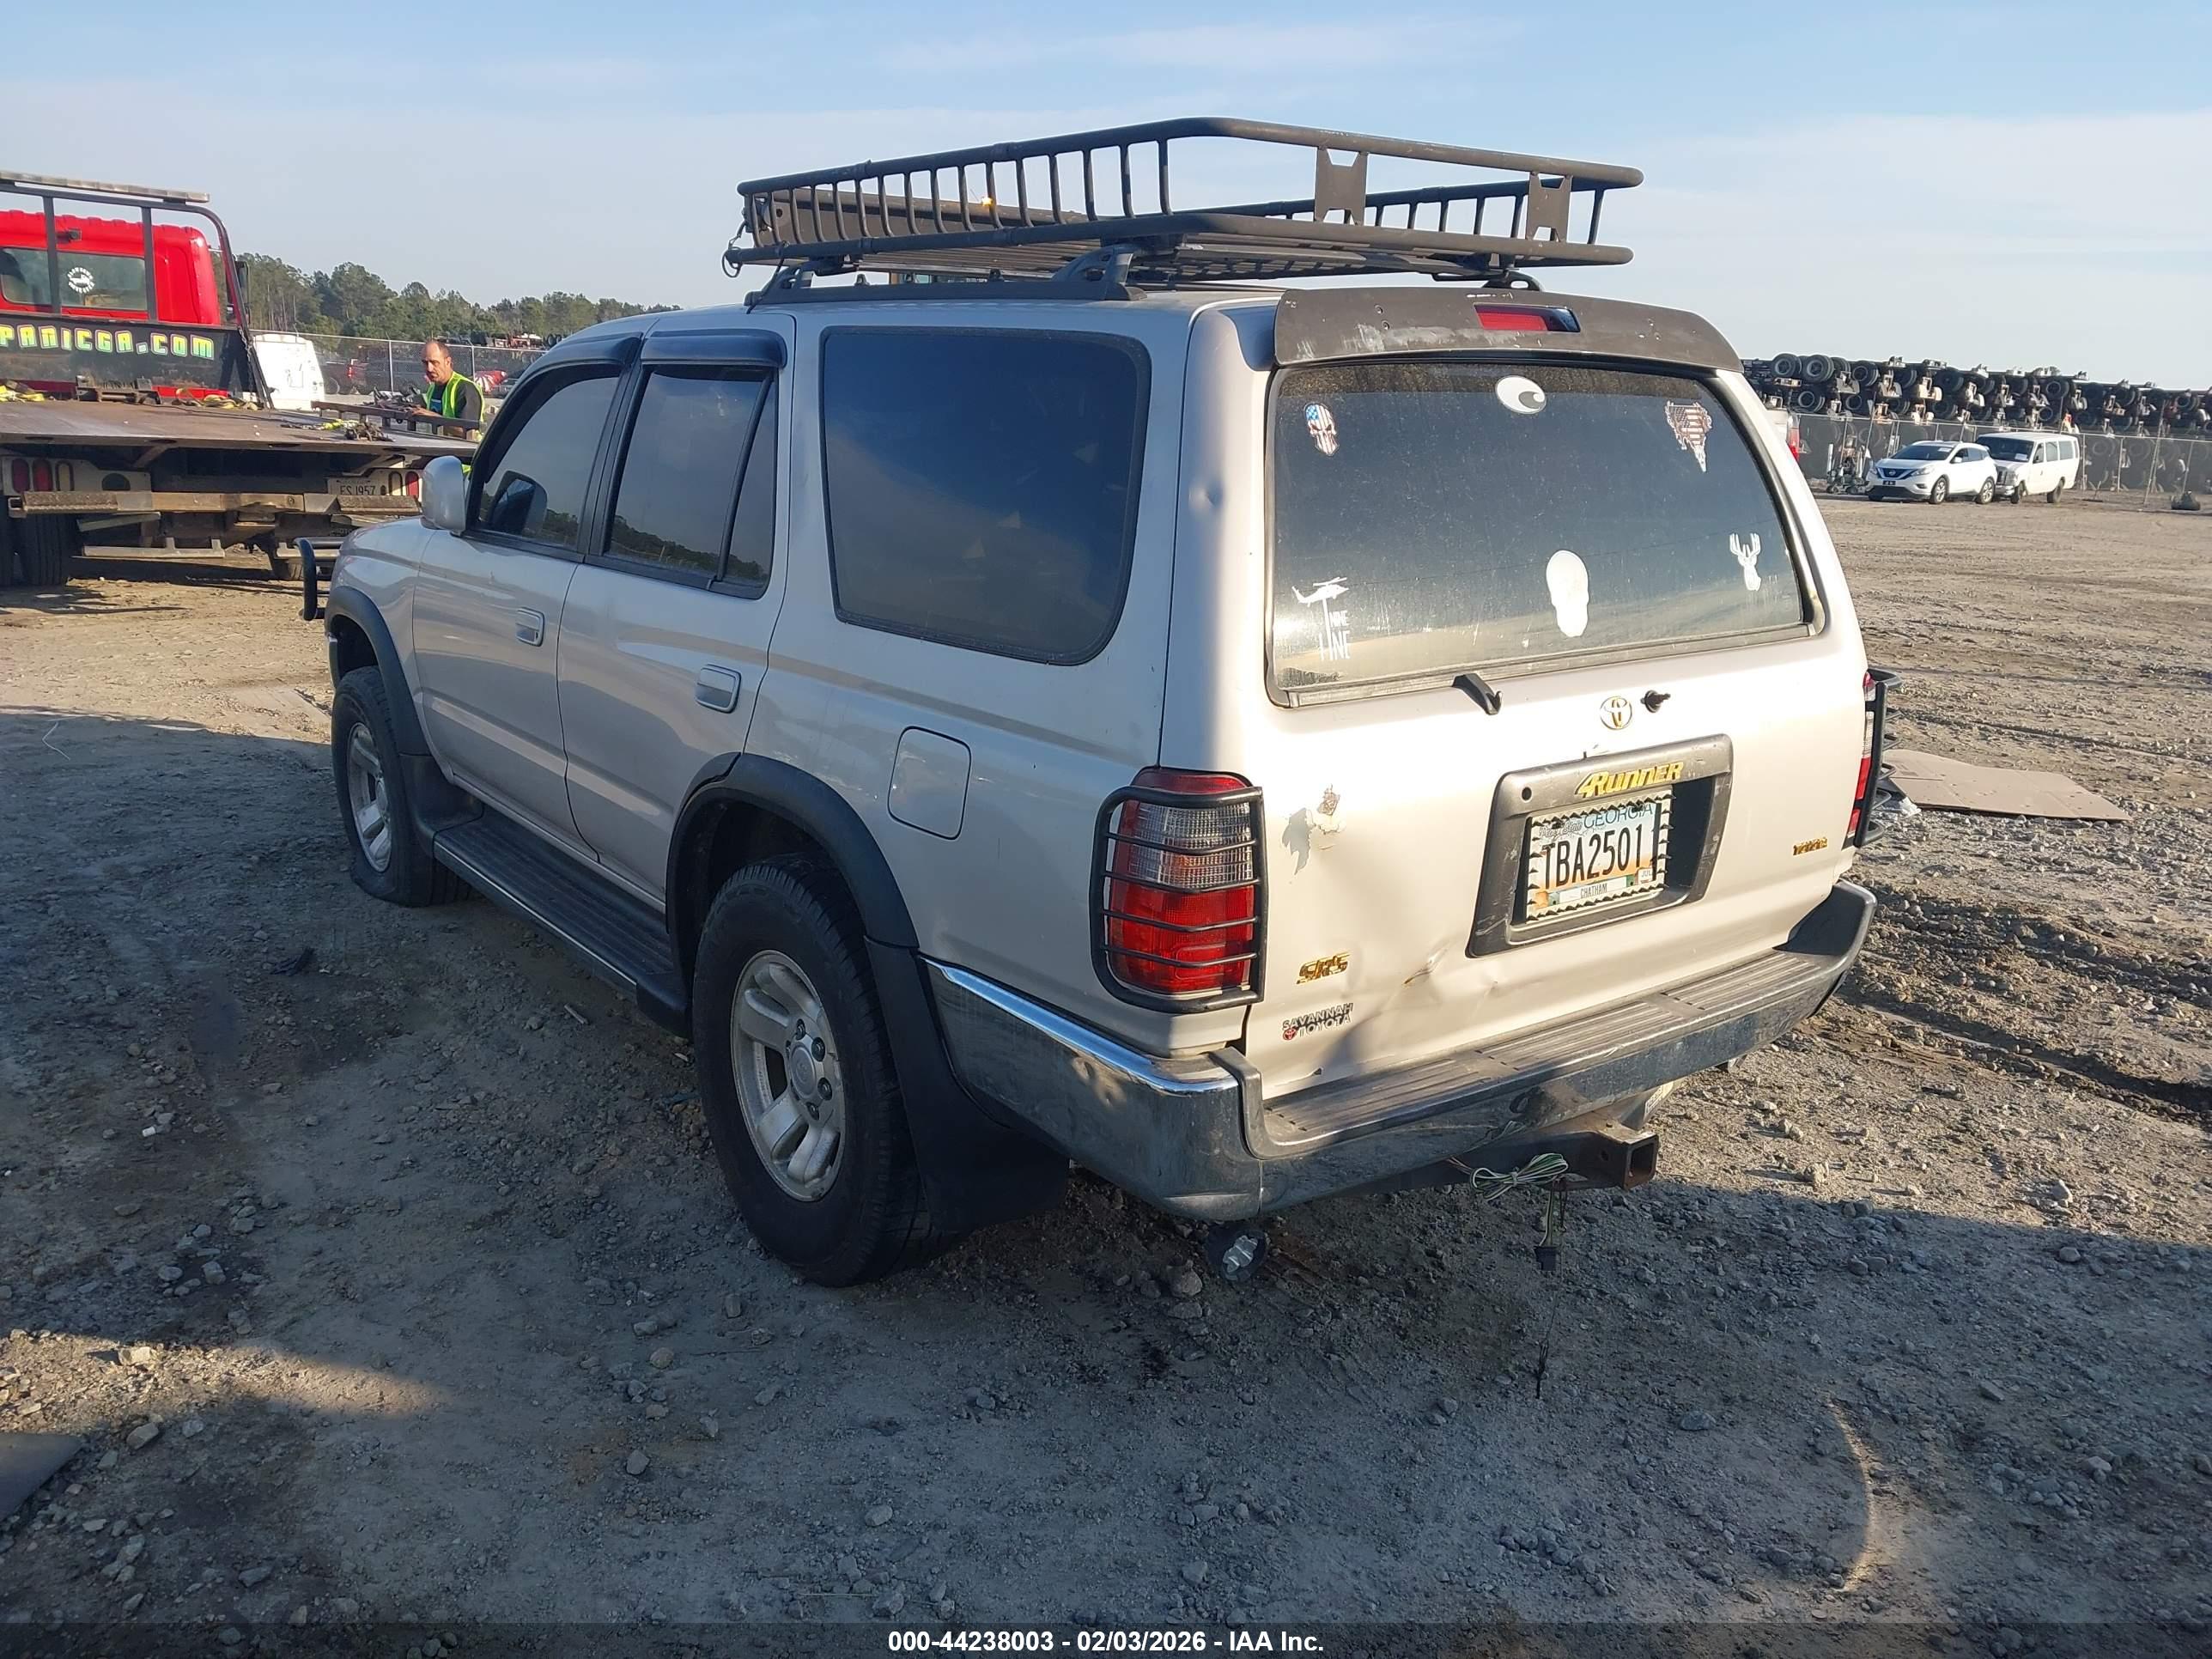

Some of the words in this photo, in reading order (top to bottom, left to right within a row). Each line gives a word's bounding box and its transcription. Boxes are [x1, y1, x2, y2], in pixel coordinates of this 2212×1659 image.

[356, 485, 376, 495] 1957
[1583, 804, 1654, 829] GEORGIA
[1541, 823, 1644, 890] TBA2501
[1580, 883, 1608, 899] CHATHAM
[1282, 1003, 1354, 1031] SAVANNAH
[1299, 1013, 1352, 1037] TOYOTA
